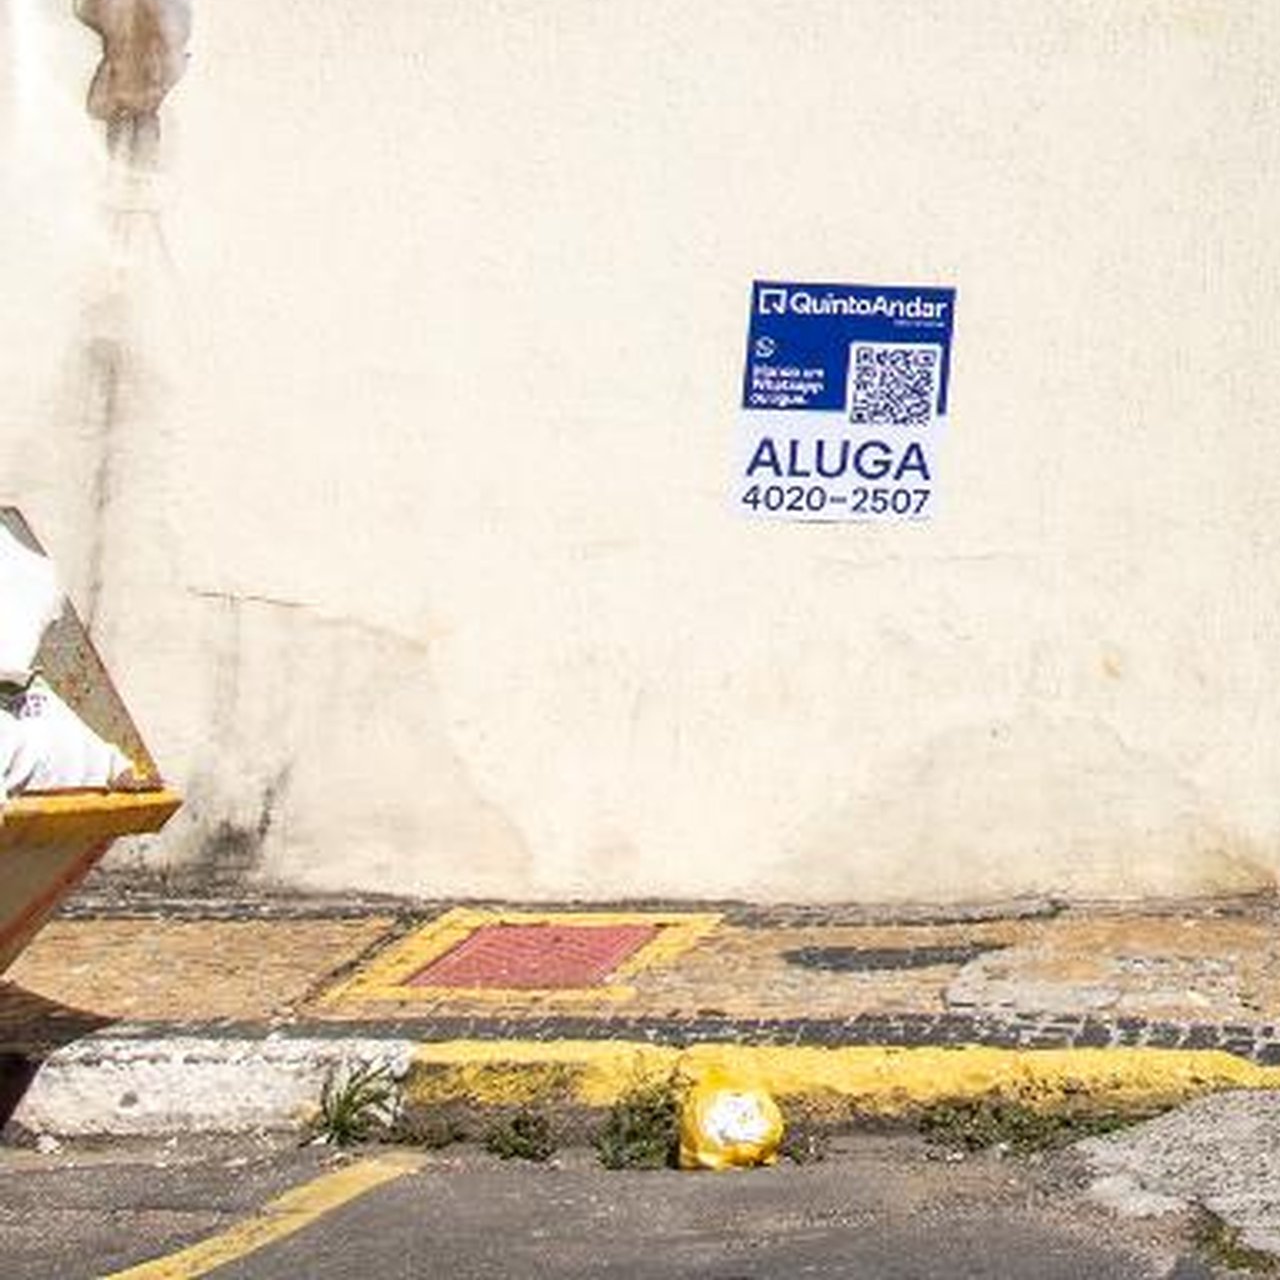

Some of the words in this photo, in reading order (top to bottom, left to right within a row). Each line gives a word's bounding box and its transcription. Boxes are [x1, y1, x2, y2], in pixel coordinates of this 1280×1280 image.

[790, 291, 949, 319] QuintoAndar
[745, 436, 931, 481] ALUGA
[742, 484, 931, 515] 4020-2507
